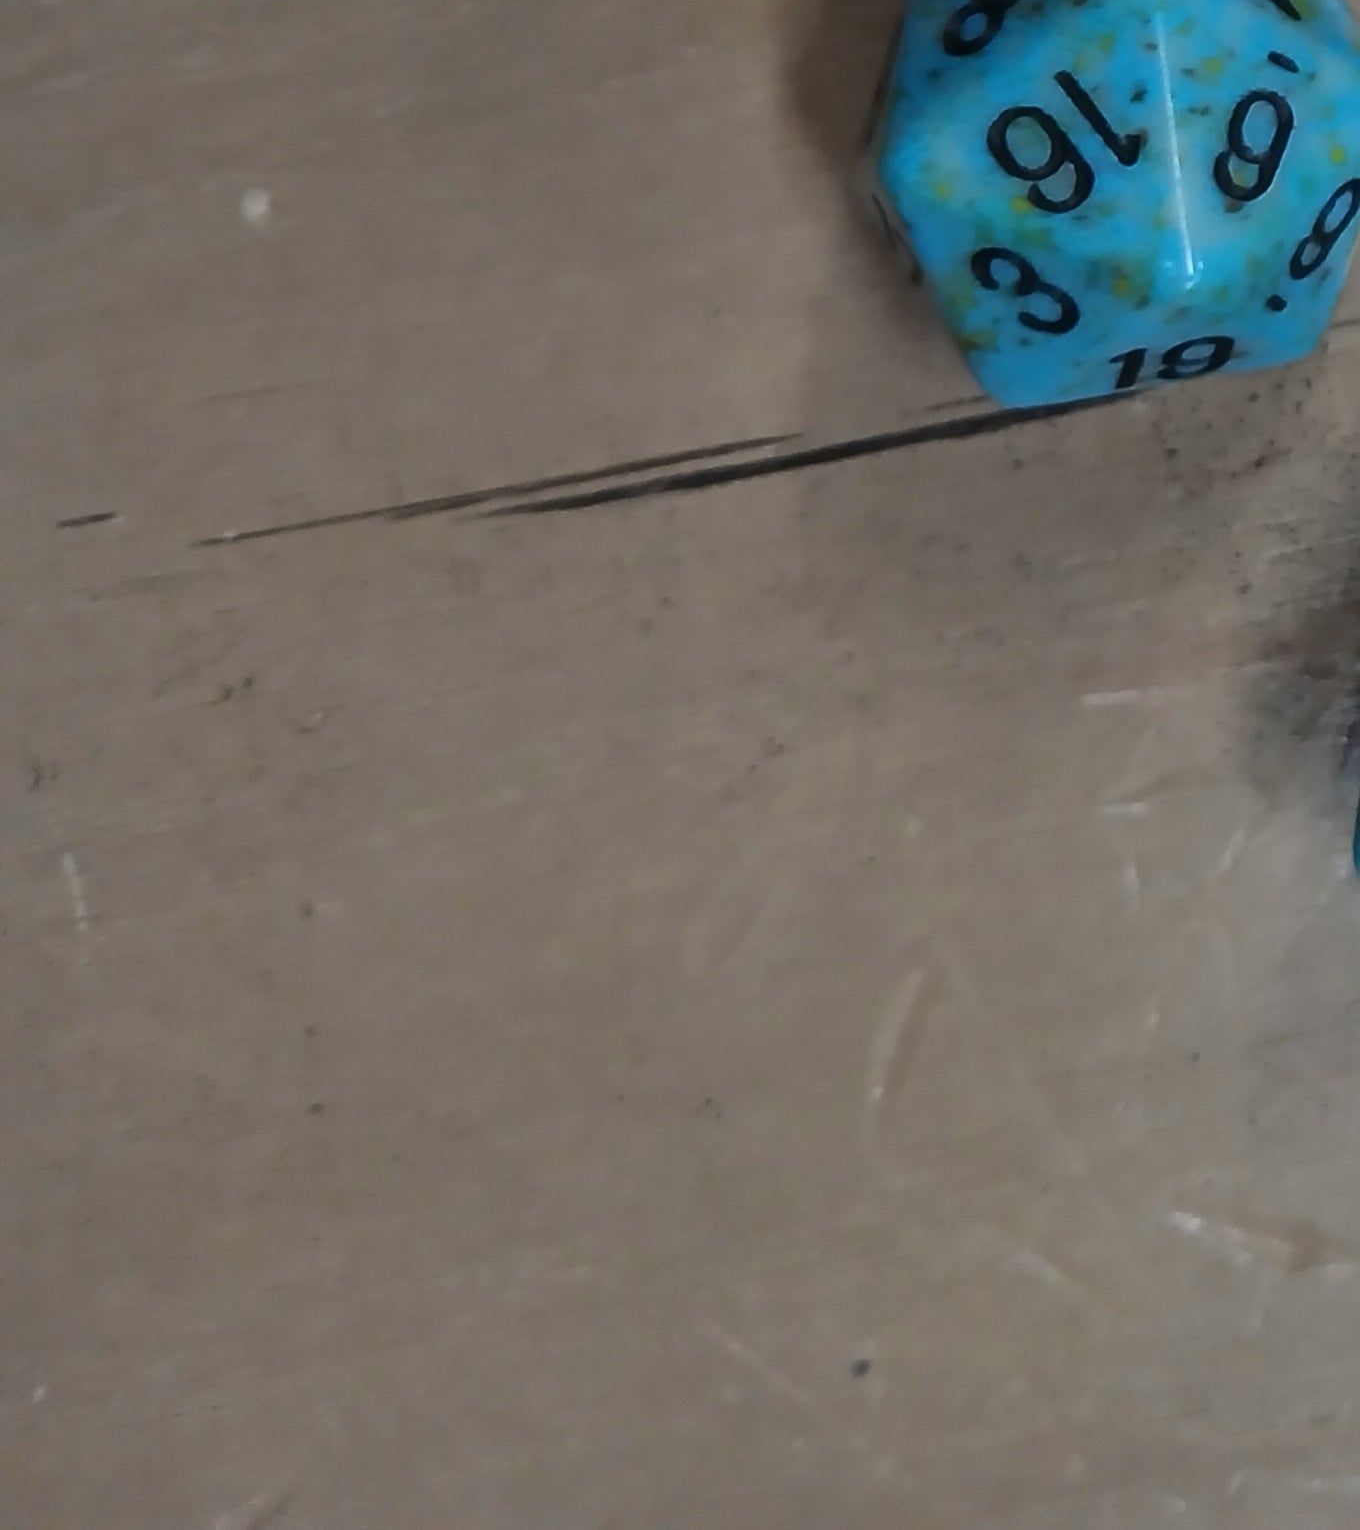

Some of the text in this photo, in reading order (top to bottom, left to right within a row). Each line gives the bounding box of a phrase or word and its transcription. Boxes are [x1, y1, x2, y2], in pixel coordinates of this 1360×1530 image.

[986, 69, 1142, 215] 16
[969, 246, 1081, 335] 3
[1108, 335, 1237, 390] 19
